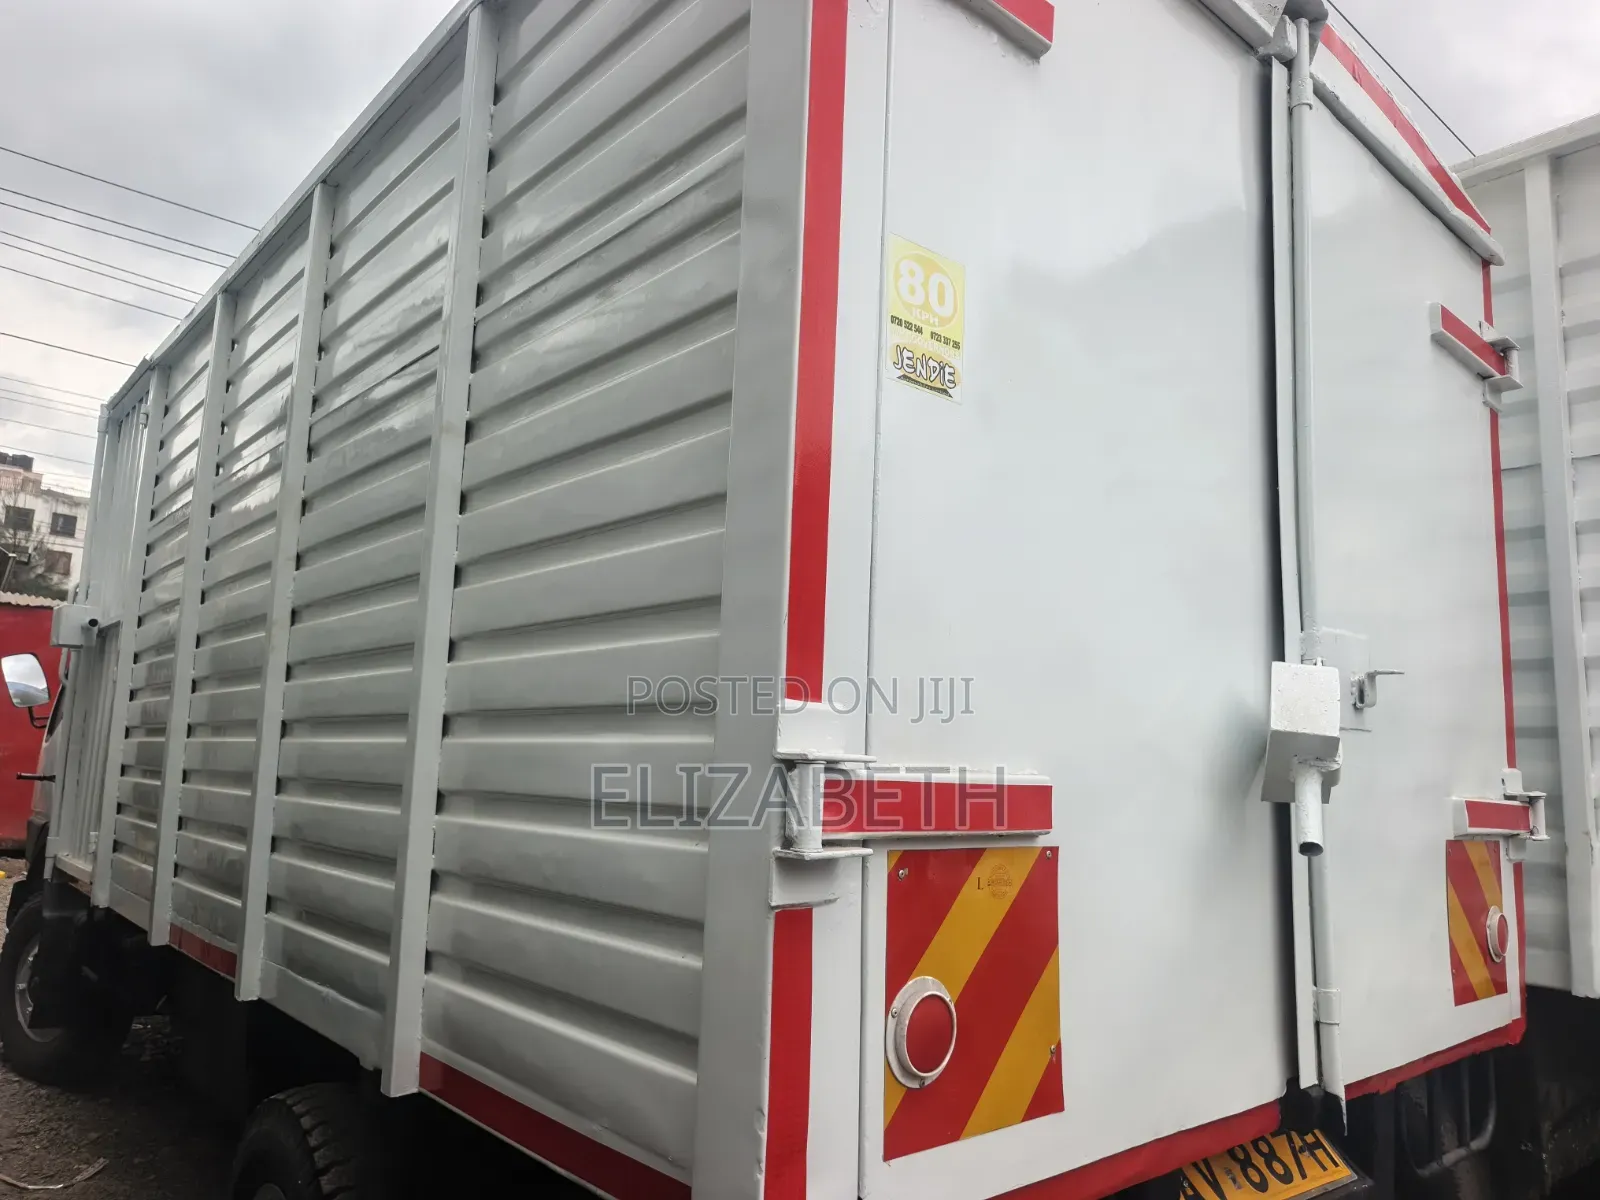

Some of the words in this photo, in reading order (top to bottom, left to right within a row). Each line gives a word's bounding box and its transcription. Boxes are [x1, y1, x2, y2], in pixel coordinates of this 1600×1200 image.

[897, 258, 955, 318] 80
[912, 307, 939, 328] KPH
[893, 344, 956, 389] JENDIE
